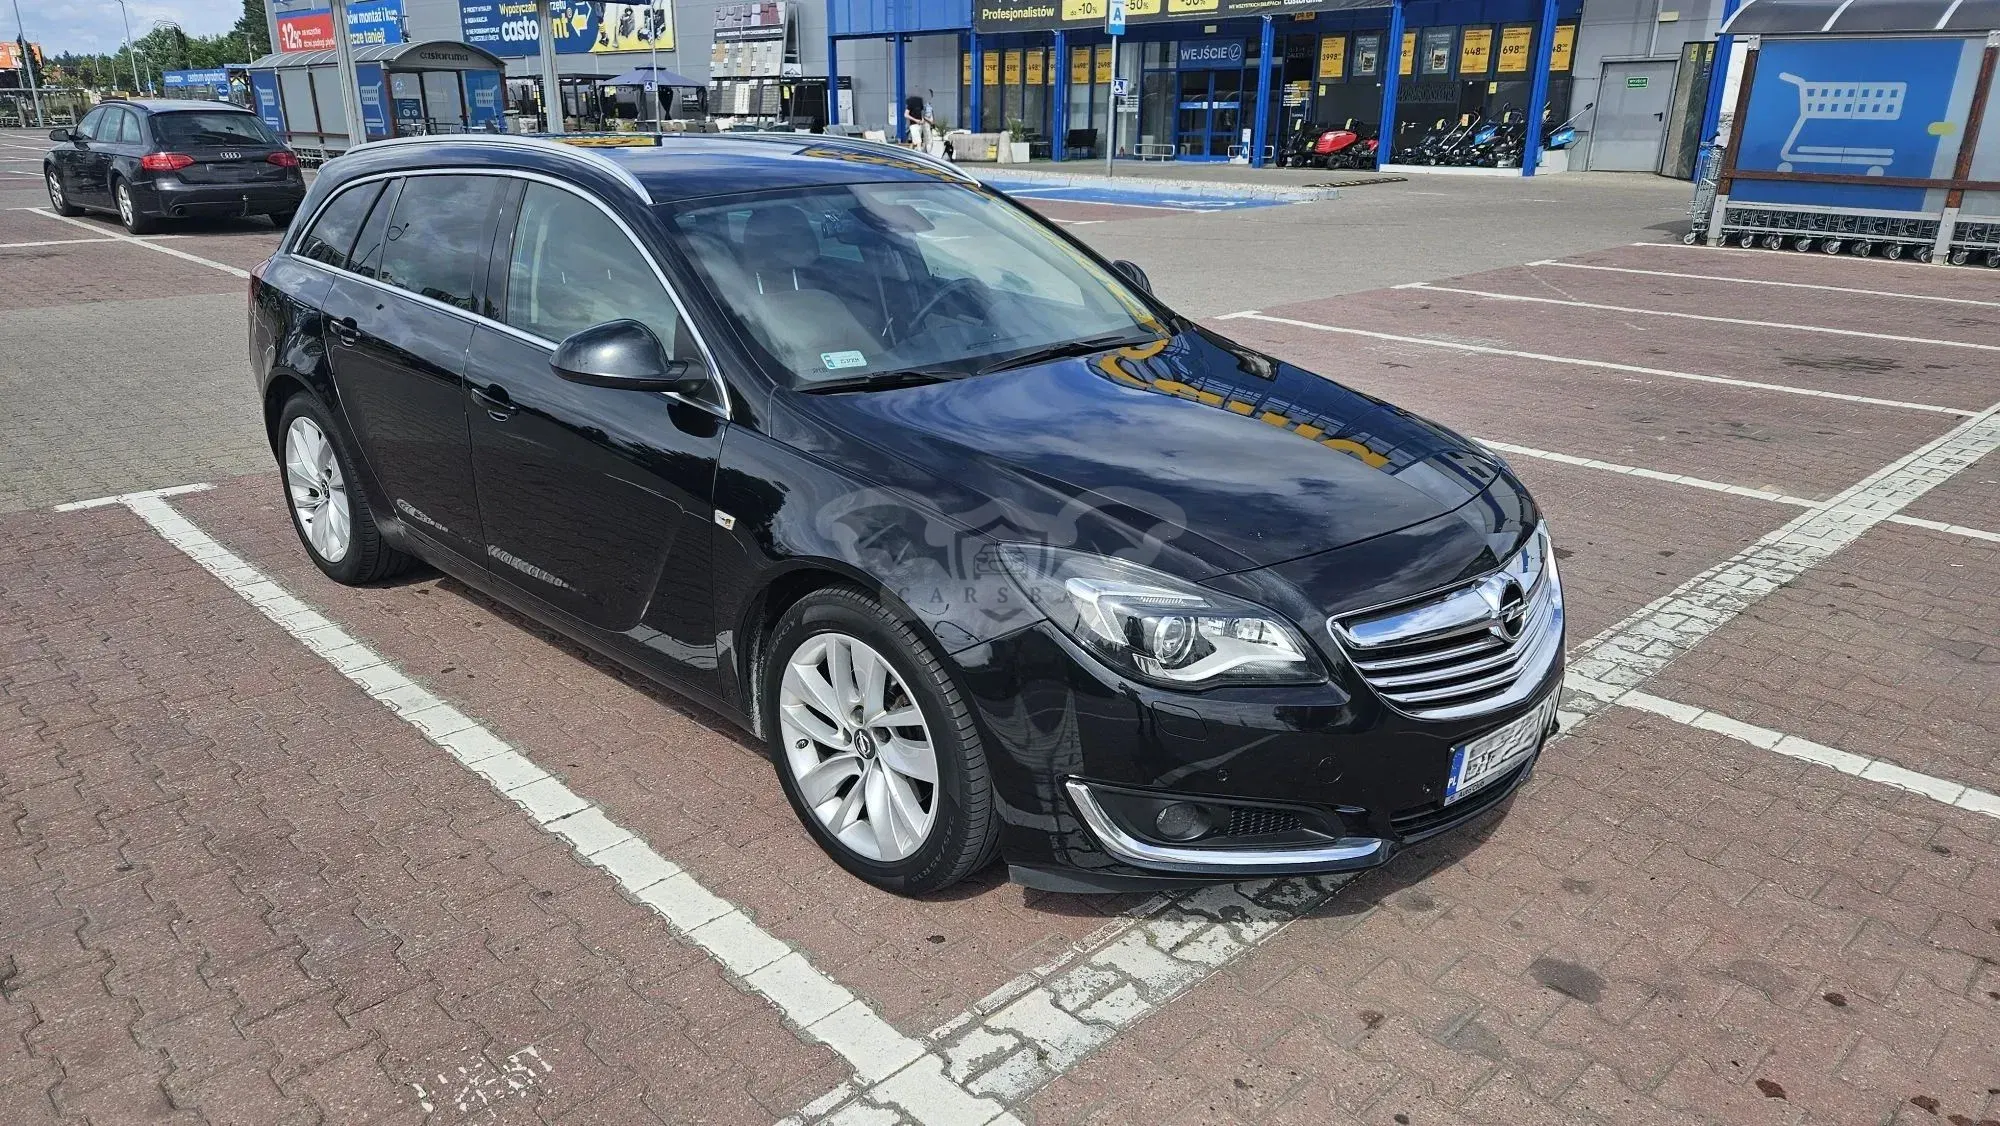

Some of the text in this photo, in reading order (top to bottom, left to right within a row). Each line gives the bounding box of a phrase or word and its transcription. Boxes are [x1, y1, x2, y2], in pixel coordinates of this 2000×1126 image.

[359, 7, 382, 23] montaż
[499, 1, 567, 16] Wypożyczaln rzętu
[982, 5, 1055, 22] Profesjonalistów
[1113, 7, 1122, 21] A
[501, 14, 570, 41] castont
[282, 22, 303, 49] -12%
[420, 50, 469, 61] castorama
[1180, 44, 1228, 61] WEJŚCIE
[1464, 47, 1481, 56] 448
[1502, 45, 1520, 55] 698
[1447, 775, 1457, 789] PL
